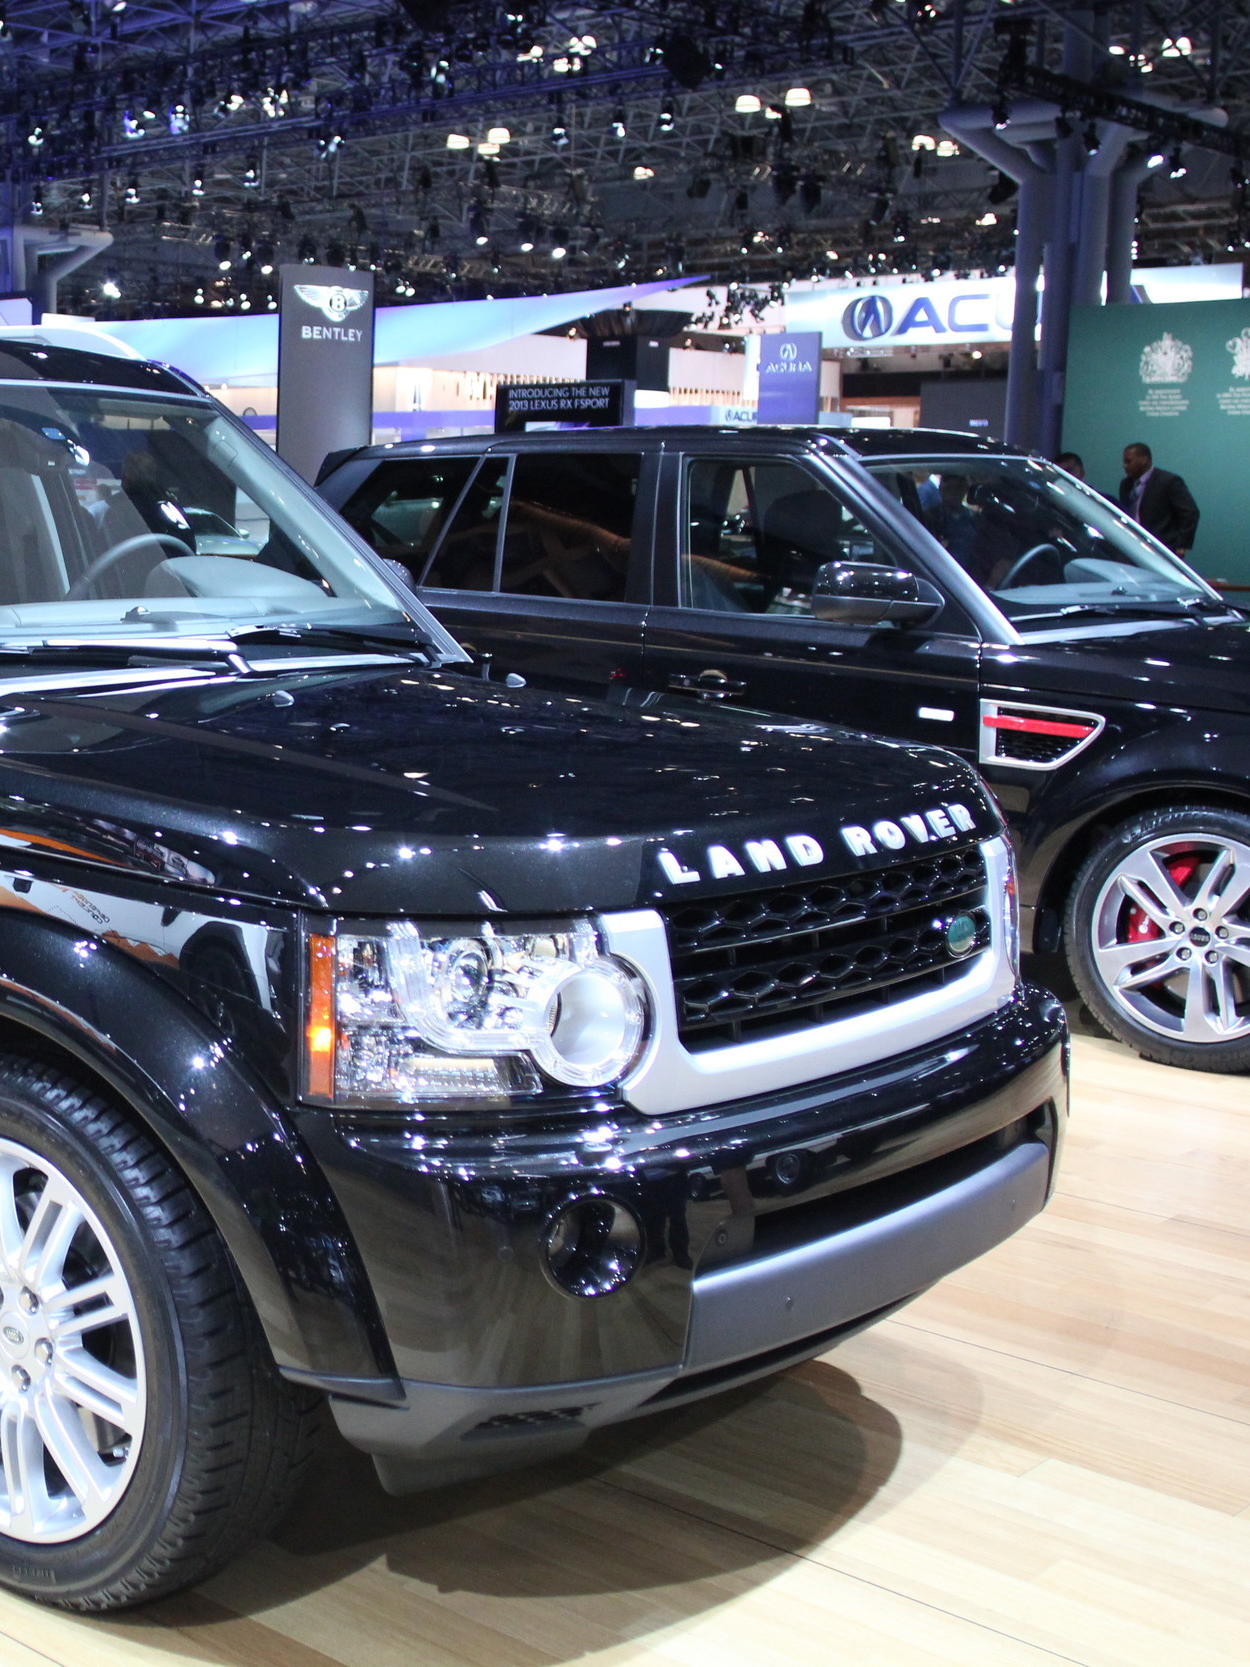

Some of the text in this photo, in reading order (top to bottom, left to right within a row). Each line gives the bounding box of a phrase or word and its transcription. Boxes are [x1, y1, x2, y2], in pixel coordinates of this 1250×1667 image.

[301, 325, 363, 342] BENTLEY
[508, 385, 610, 399] INTRODUCING THE NEW
[508, 399, 529, 411] 2013
[530, 398, 558, 410] LEXUS
[560, 398, 573, 409] RX
[657, 803, 977, 885] LAND ROVER
